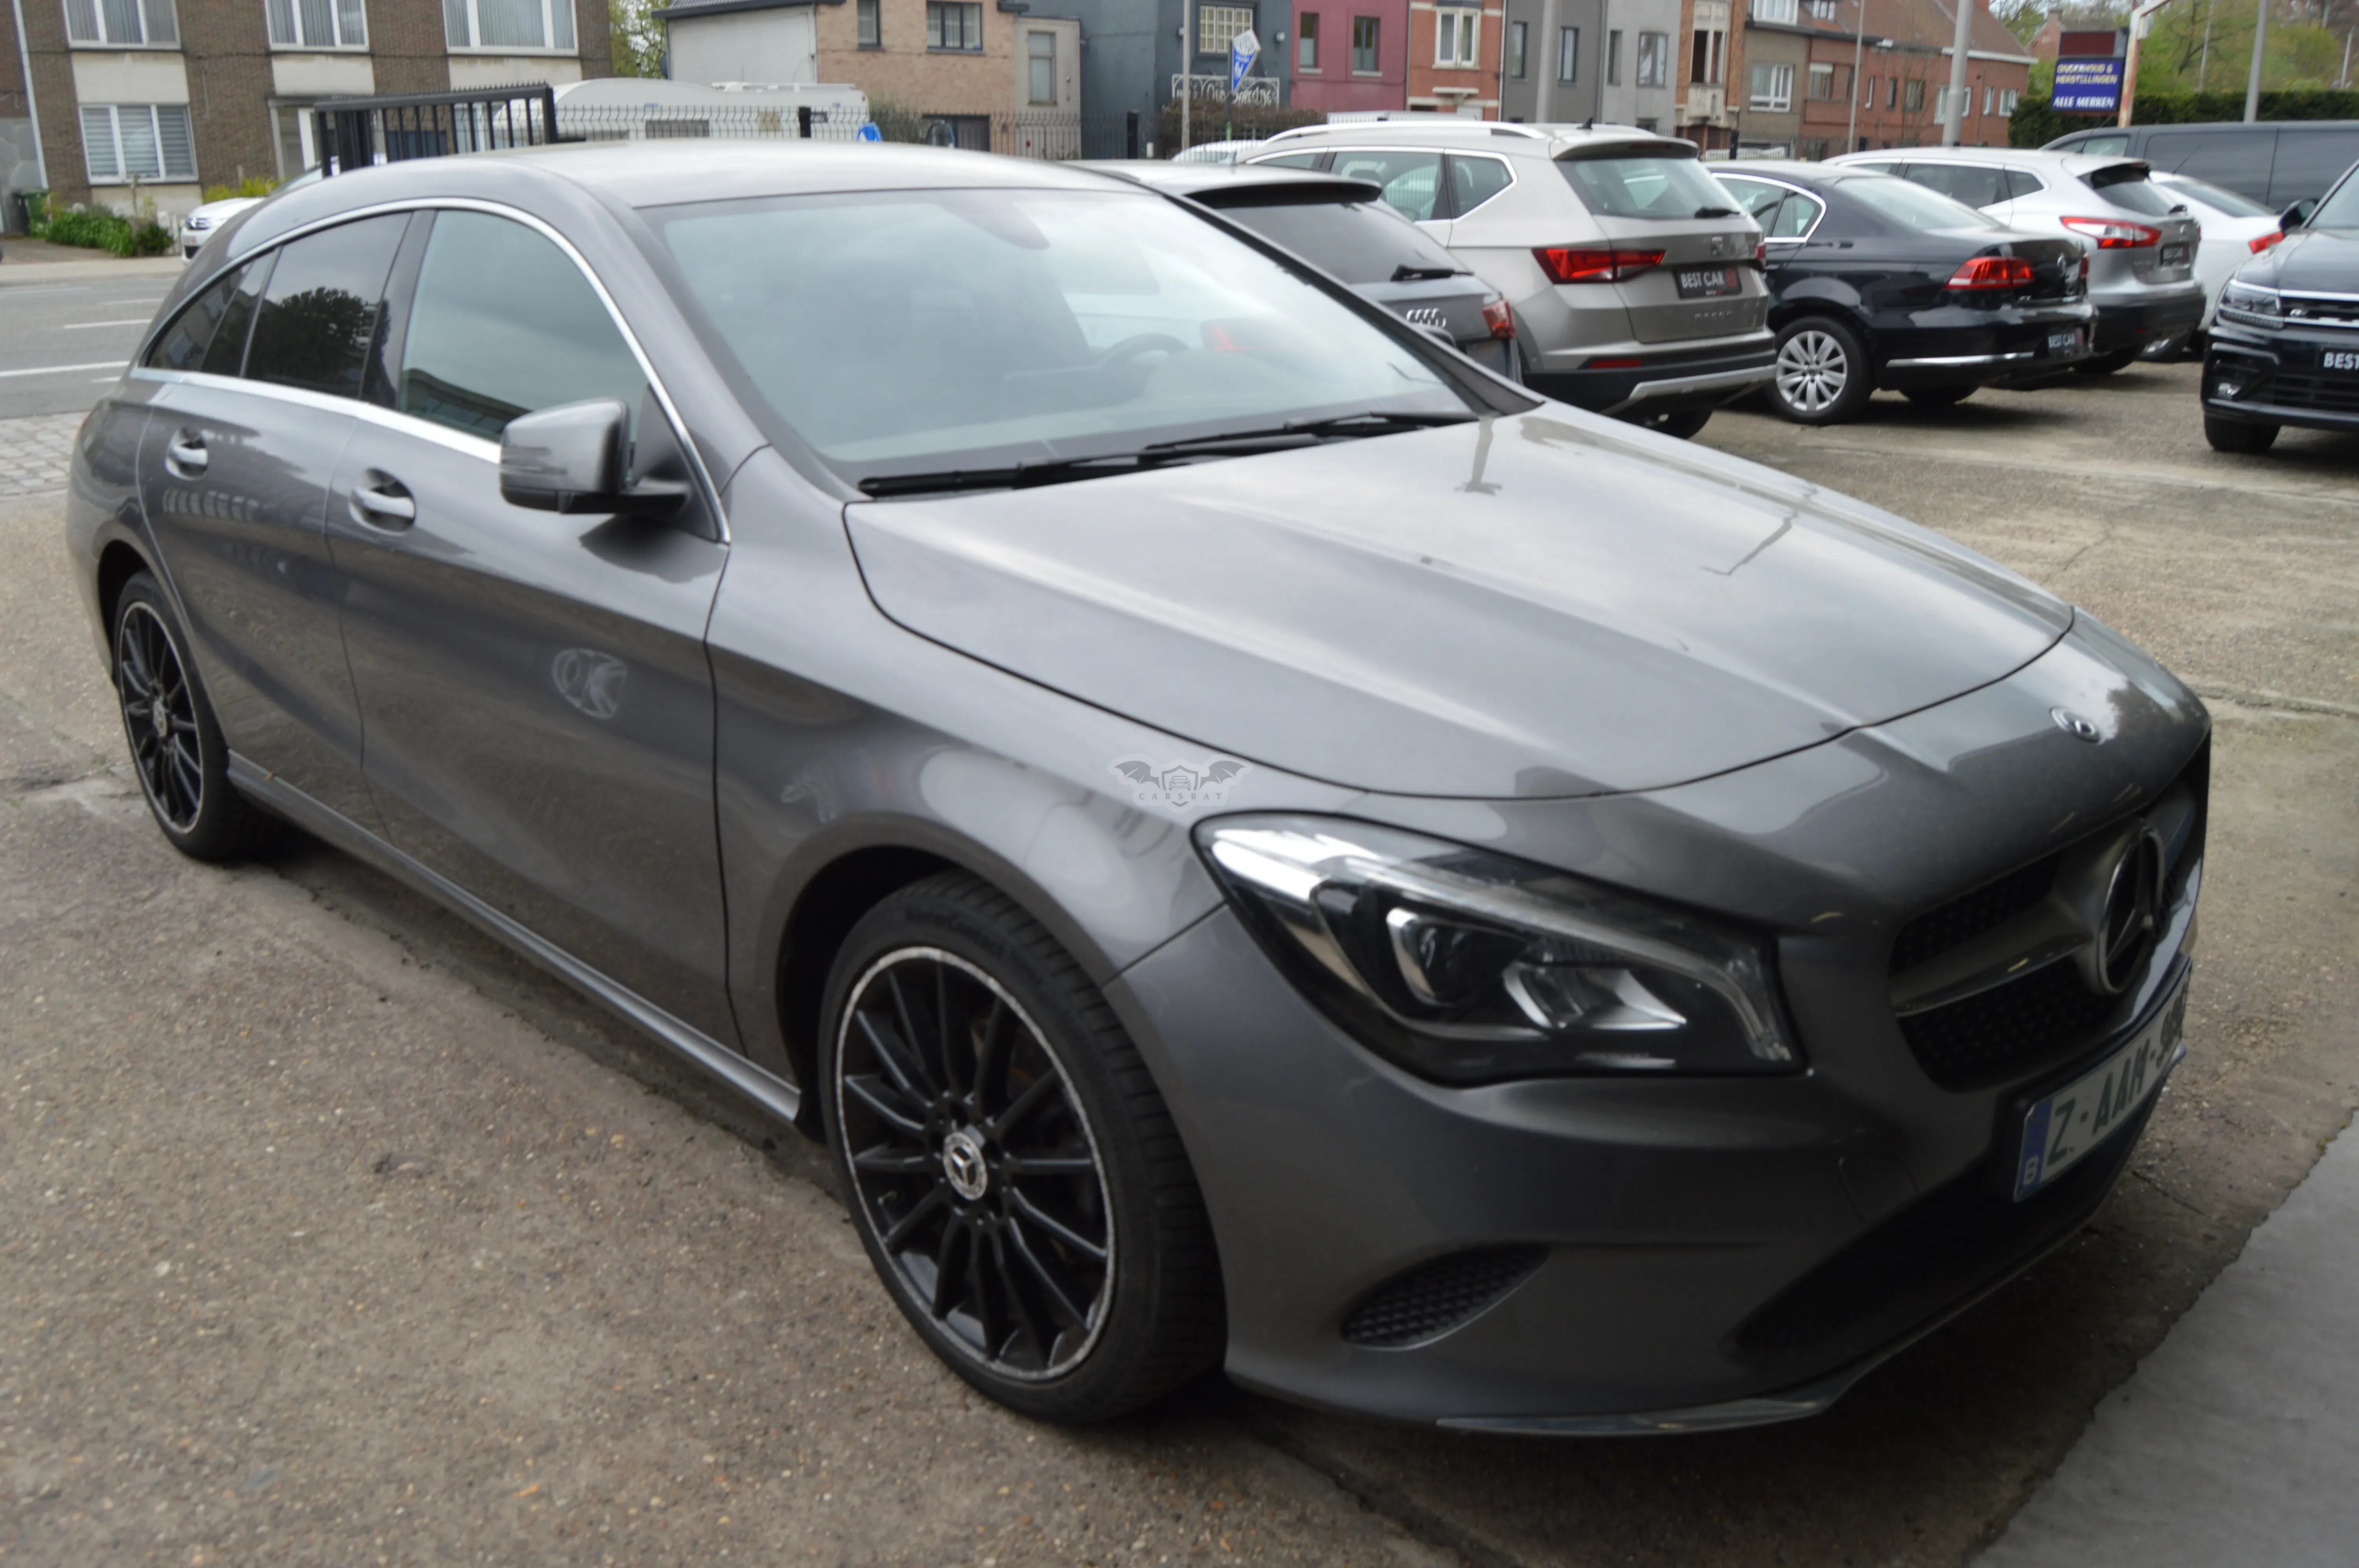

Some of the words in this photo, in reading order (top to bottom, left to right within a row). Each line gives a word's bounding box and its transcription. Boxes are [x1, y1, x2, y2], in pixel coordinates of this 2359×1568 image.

[2055, 74, 2117, 85] HERSTELLINGEN
[2053, 96, 2075, 108] ALLE
[2075, 96, 2115, 108] MERKEN
[1680, 272, 1702, 289] BEST
[1703, 270, 1725, 287] CAR
[2048, 334, 2062, 349] BEST
[2063, 333, 2075, 347] CAR
